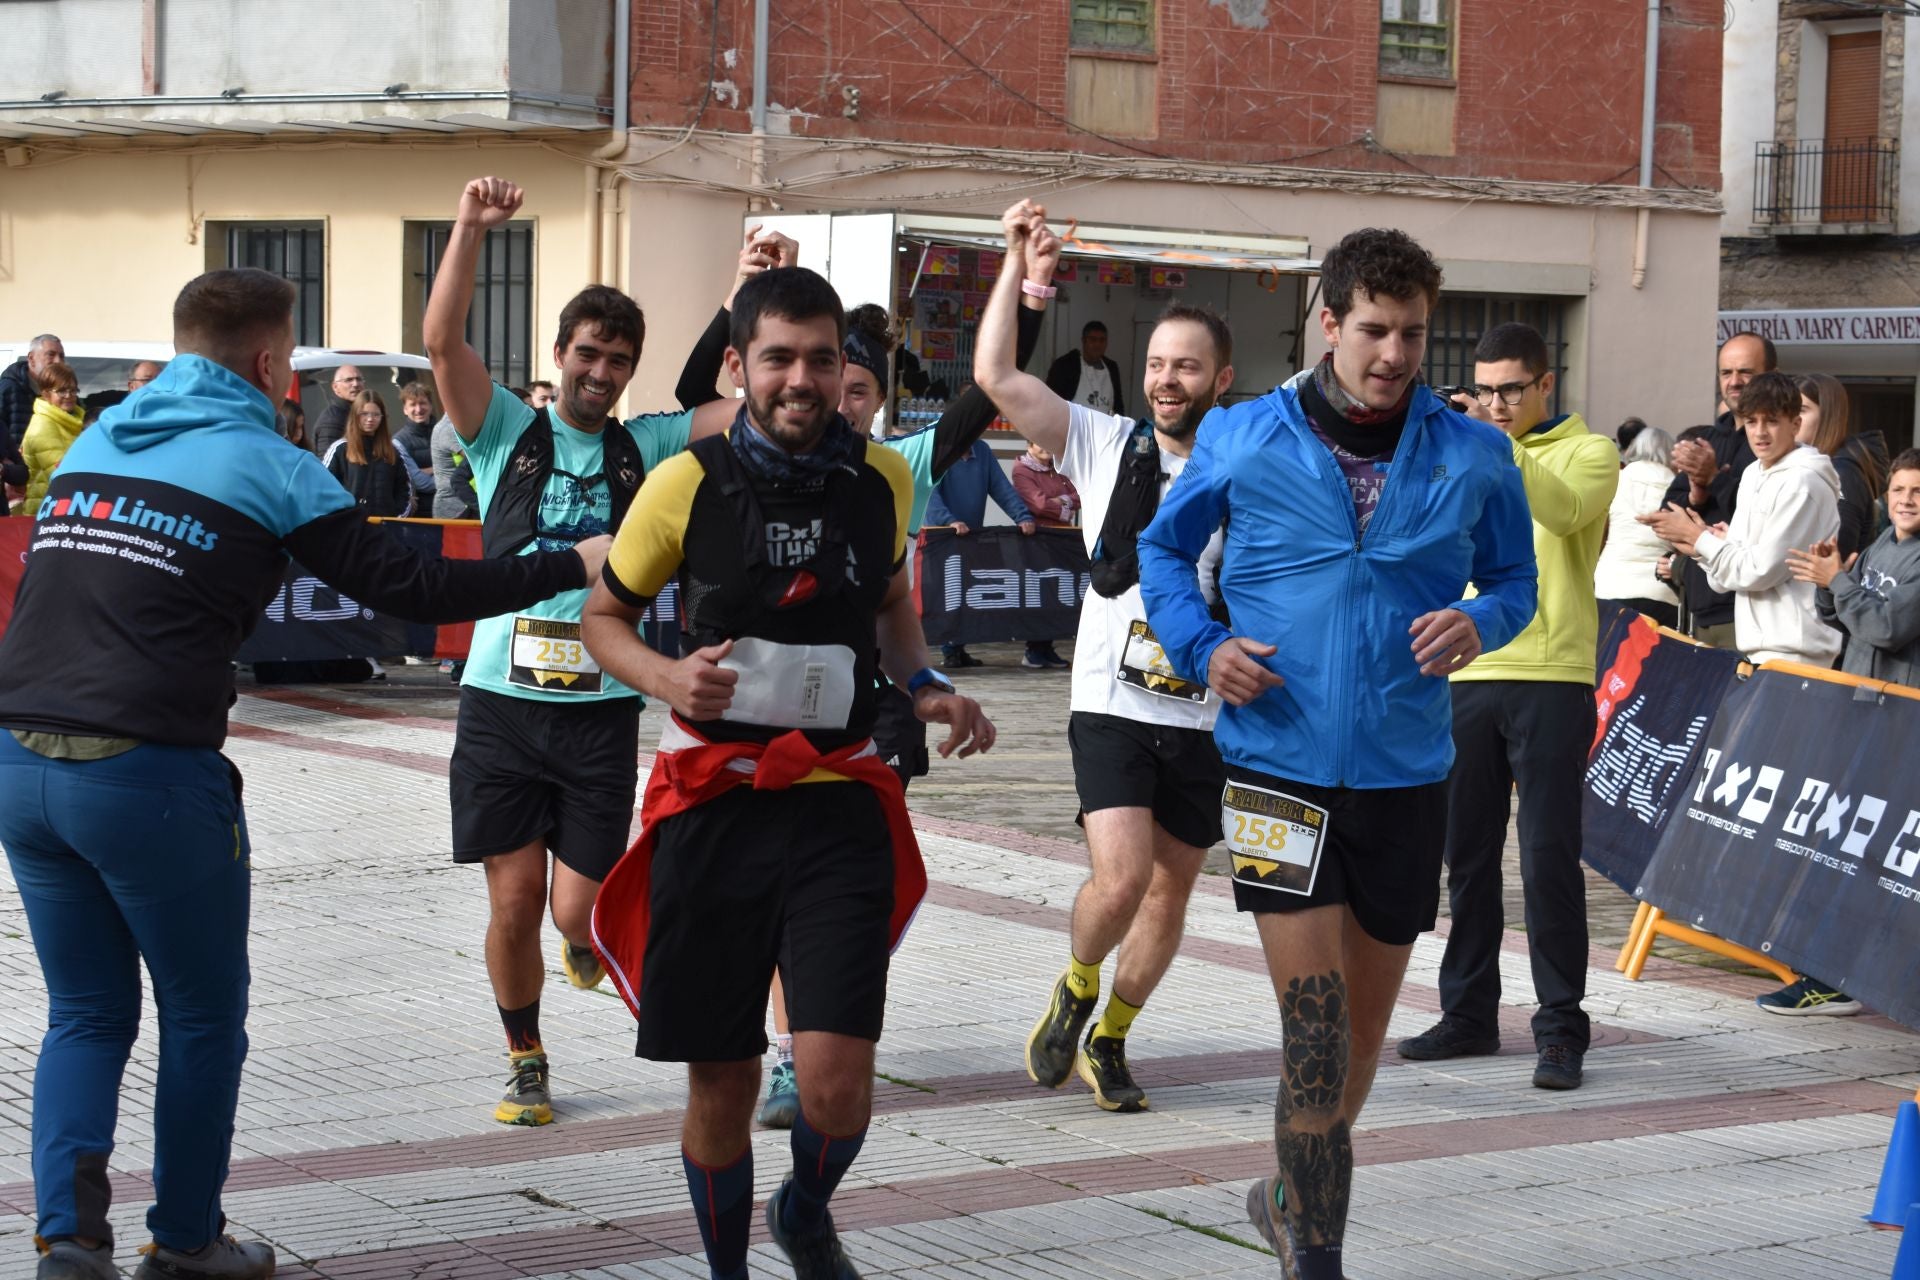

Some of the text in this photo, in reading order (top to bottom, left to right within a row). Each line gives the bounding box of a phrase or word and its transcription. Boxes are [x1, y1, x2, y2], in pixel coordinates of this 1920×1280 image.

[1796, 318, 1847, 340] MARY
[1851, 316, 1920, 339] CARMEN
[39, 523, 177, 558] Servicio de cronometraje y
[32, 537, 185, 577] gestión de eventos deportivos
[536, 640, 582, 665] 253
[1233, 815, 1288, 851] 258
[1241, 846, 1268, 857] ALBERTO
